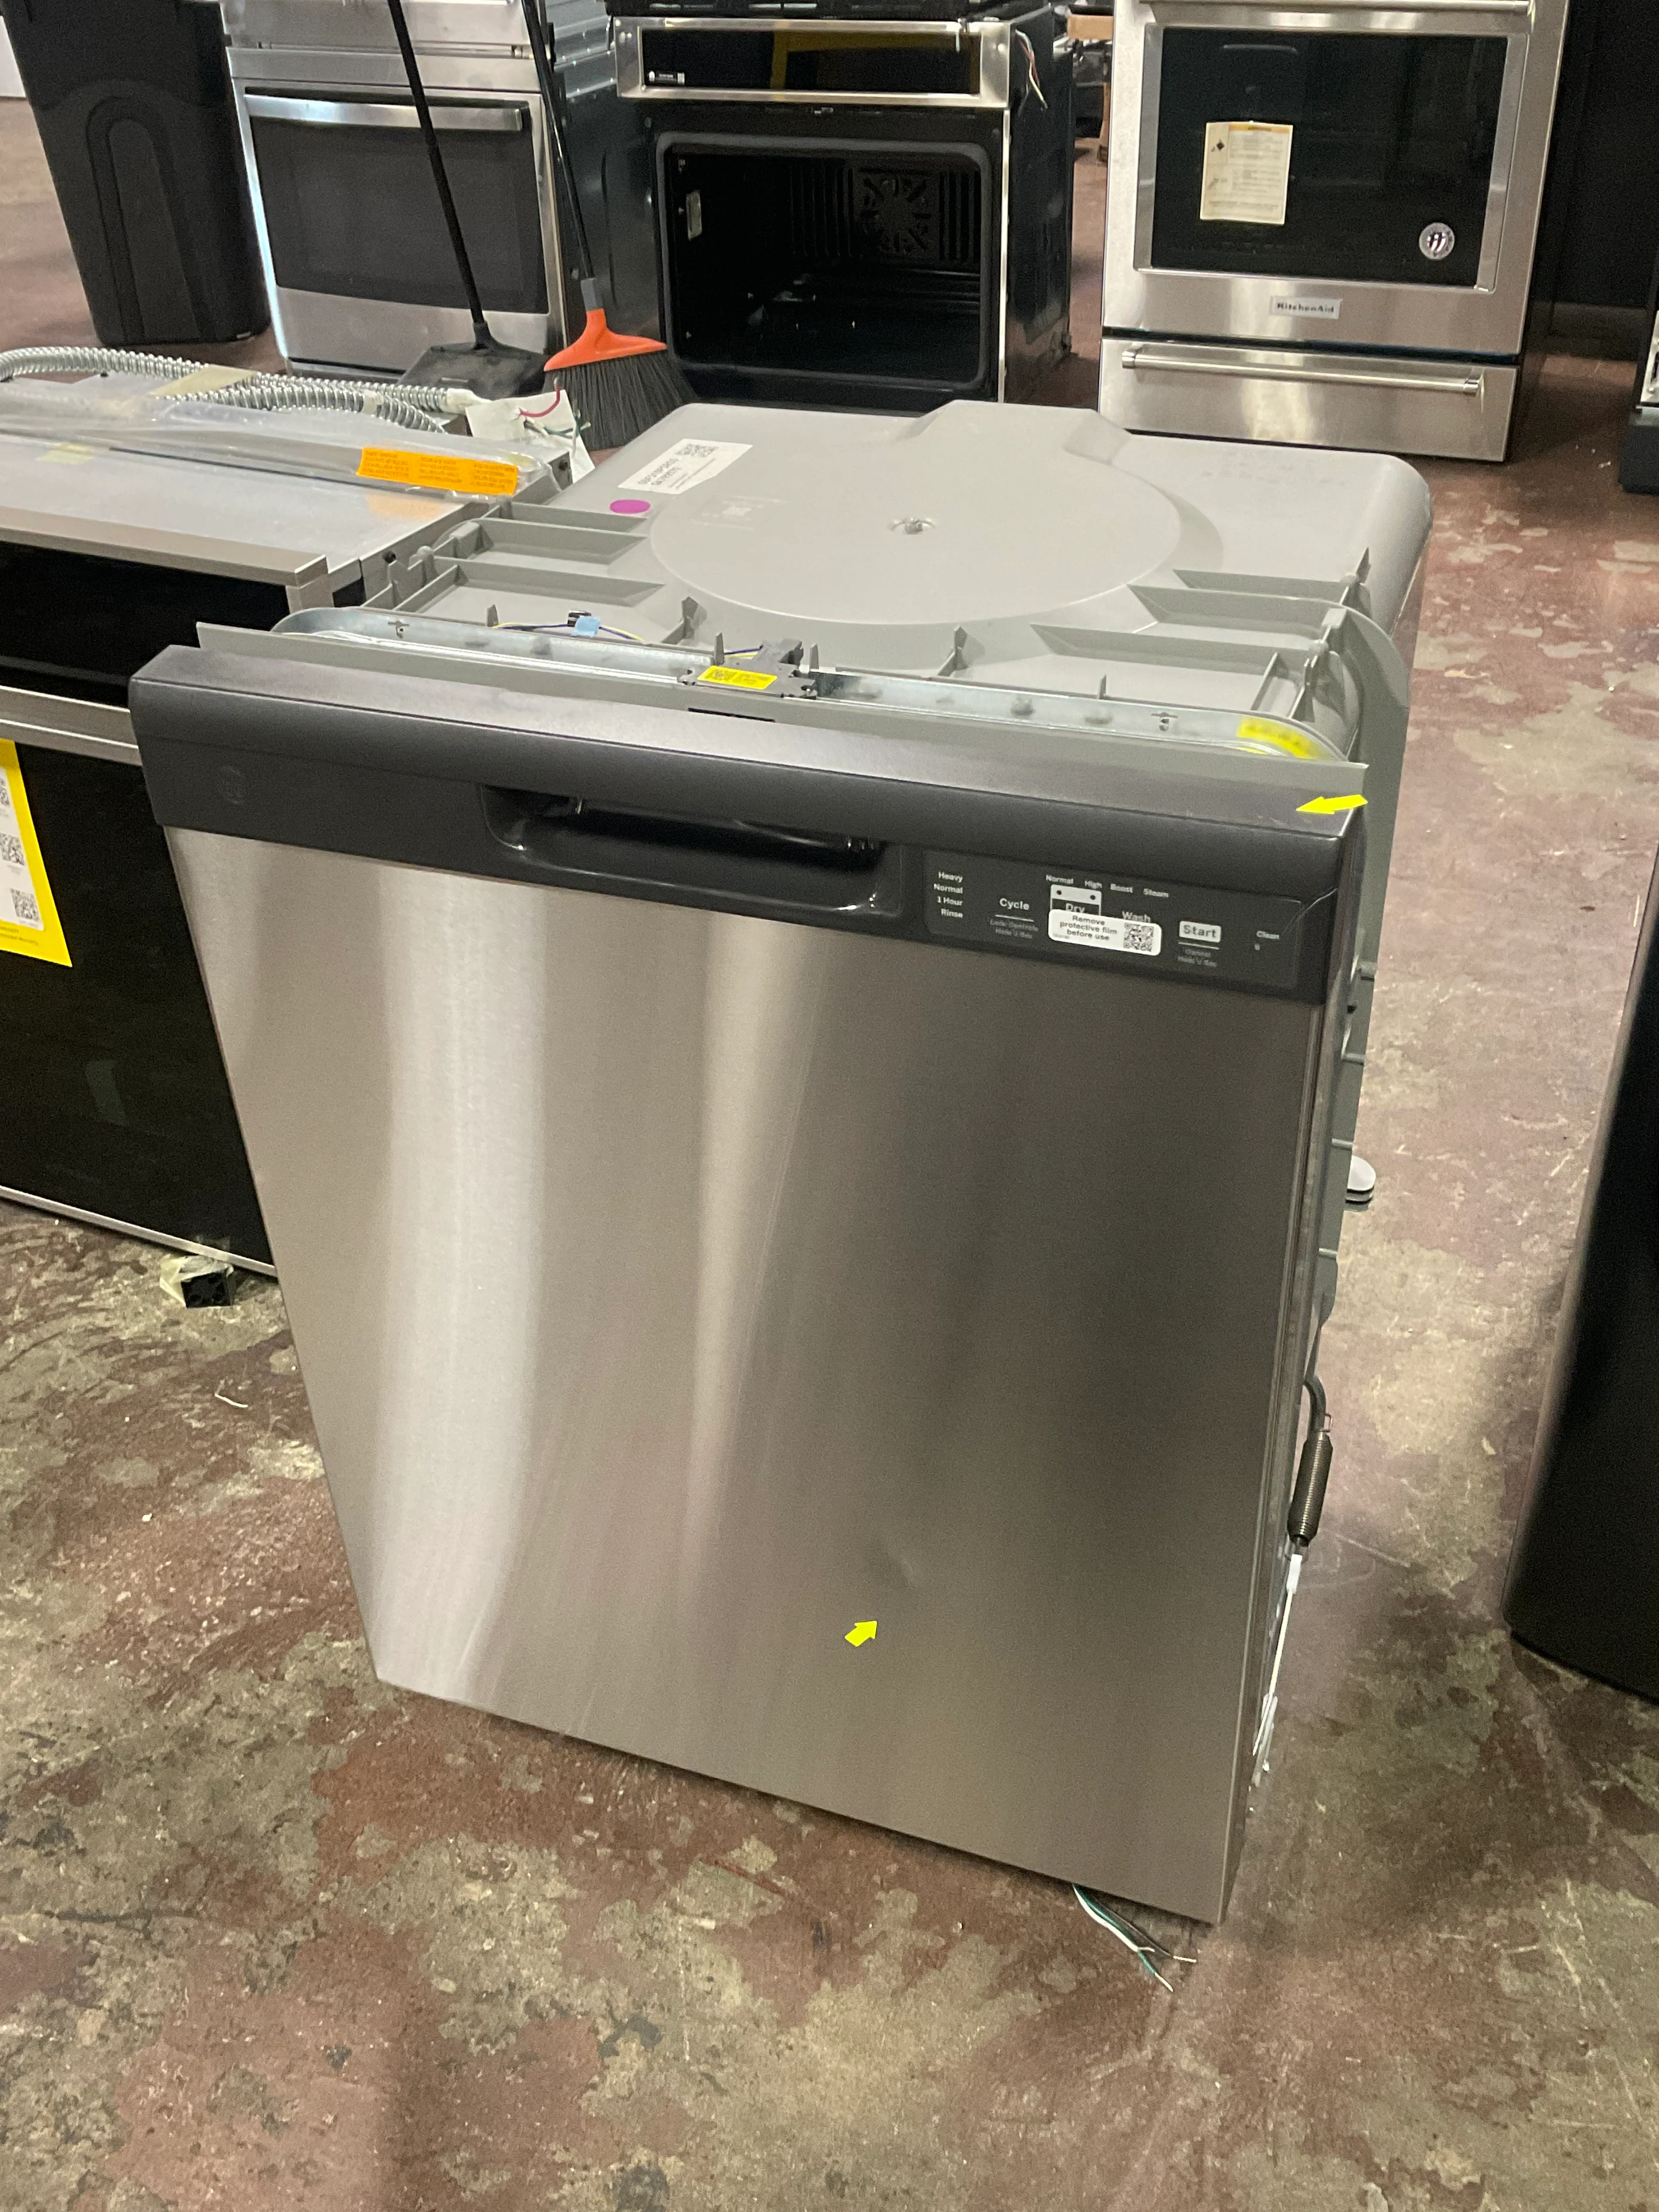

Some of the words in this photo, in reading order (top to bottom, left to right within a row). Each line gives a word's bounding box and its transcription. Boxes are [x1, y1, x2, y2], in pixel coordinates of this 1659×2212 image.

[1277, 302, 1334, 313] KitchenAid
[939, 871, 963, 883] Heavy
[1045, 874, 1074, 884] Normal
[1085, 880, 1102, 889] High
[934, 883, 963, 894] Normal
[943, 896, 963, 906] Hour
[1000, 898, 1030, 911] Cycle
[1065, 902, 1085, 913] Dry
[941, 908, 963, 919] Rinse
[1122, 911, 1151, 923] Wash
[1073, 915, 1105, 926] Remove
[1060, 922, 1100, 933] protective
[1183, 924, 1216, 938] Start
[1067, 929, 1092, 939] before
